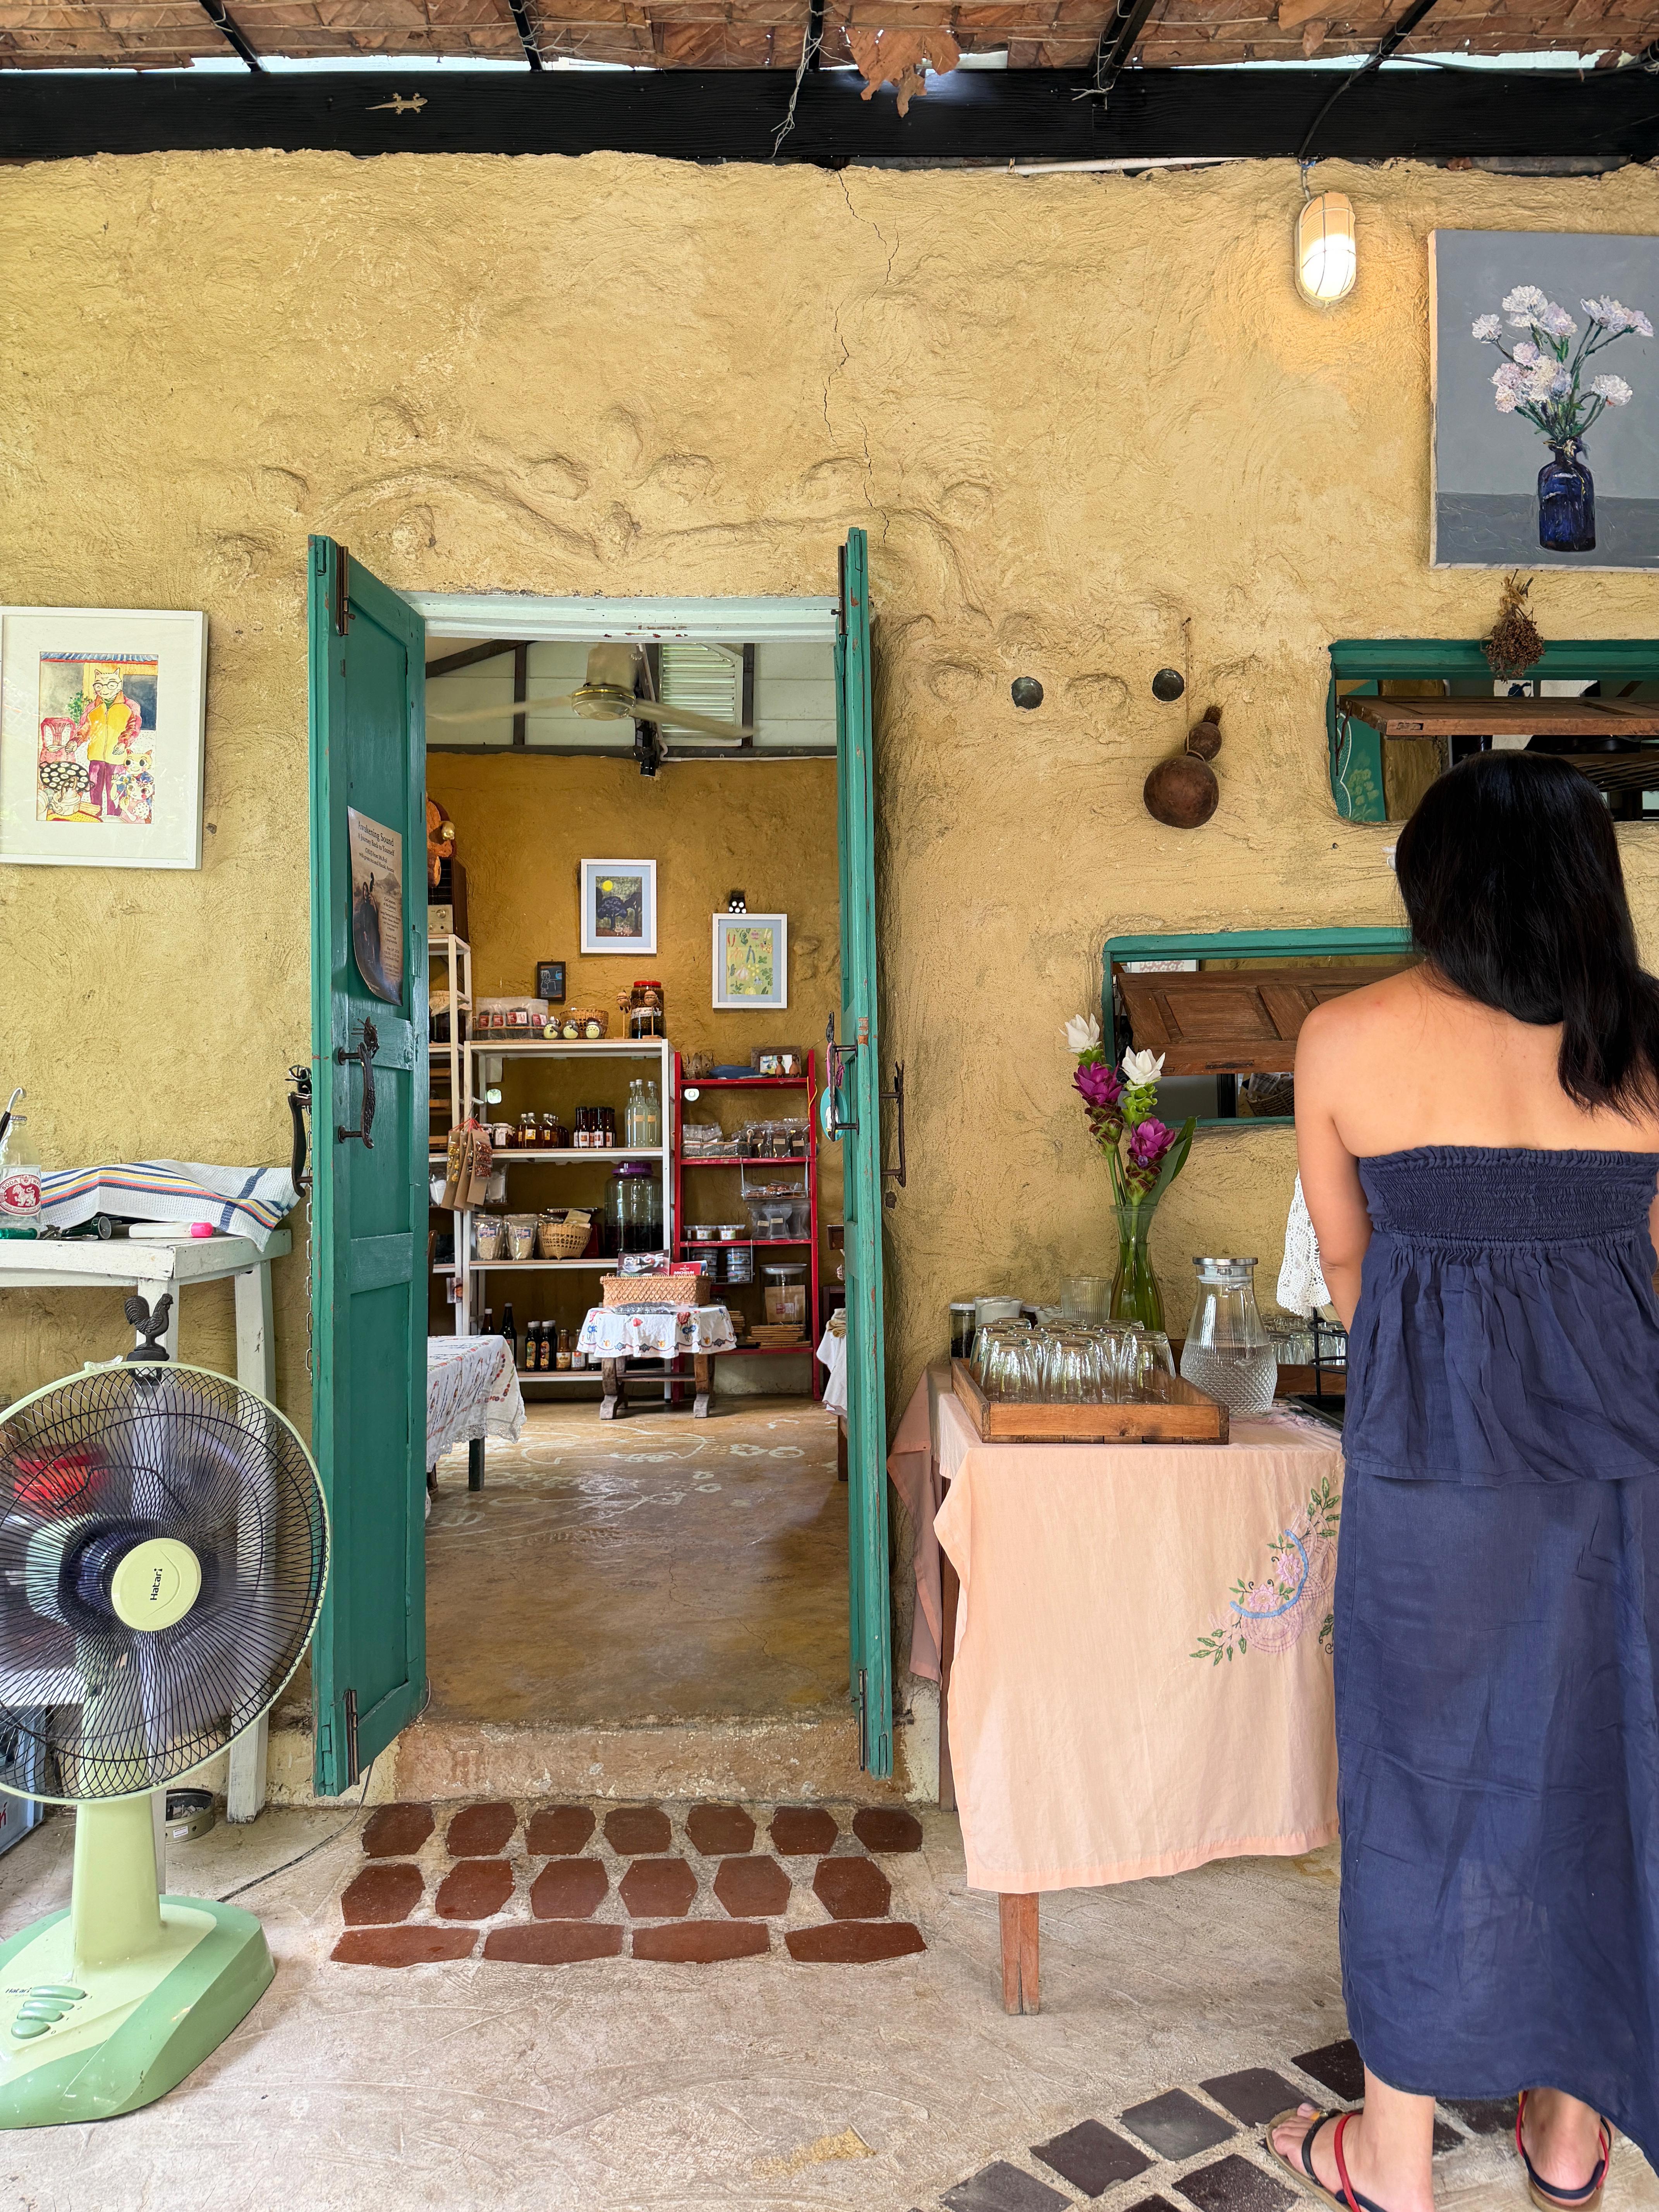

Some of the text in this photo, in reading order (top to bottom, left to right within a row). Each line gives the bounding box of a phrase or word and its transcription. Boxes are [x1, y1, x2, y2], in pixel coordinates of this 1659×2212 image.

[358, 821, 394, 846] Awakening Sound
[382, 845, 395, 856] Yourself
[2, 1179, 18, 1190] SODA
[150, 1568, 163, 1601] Hatari
